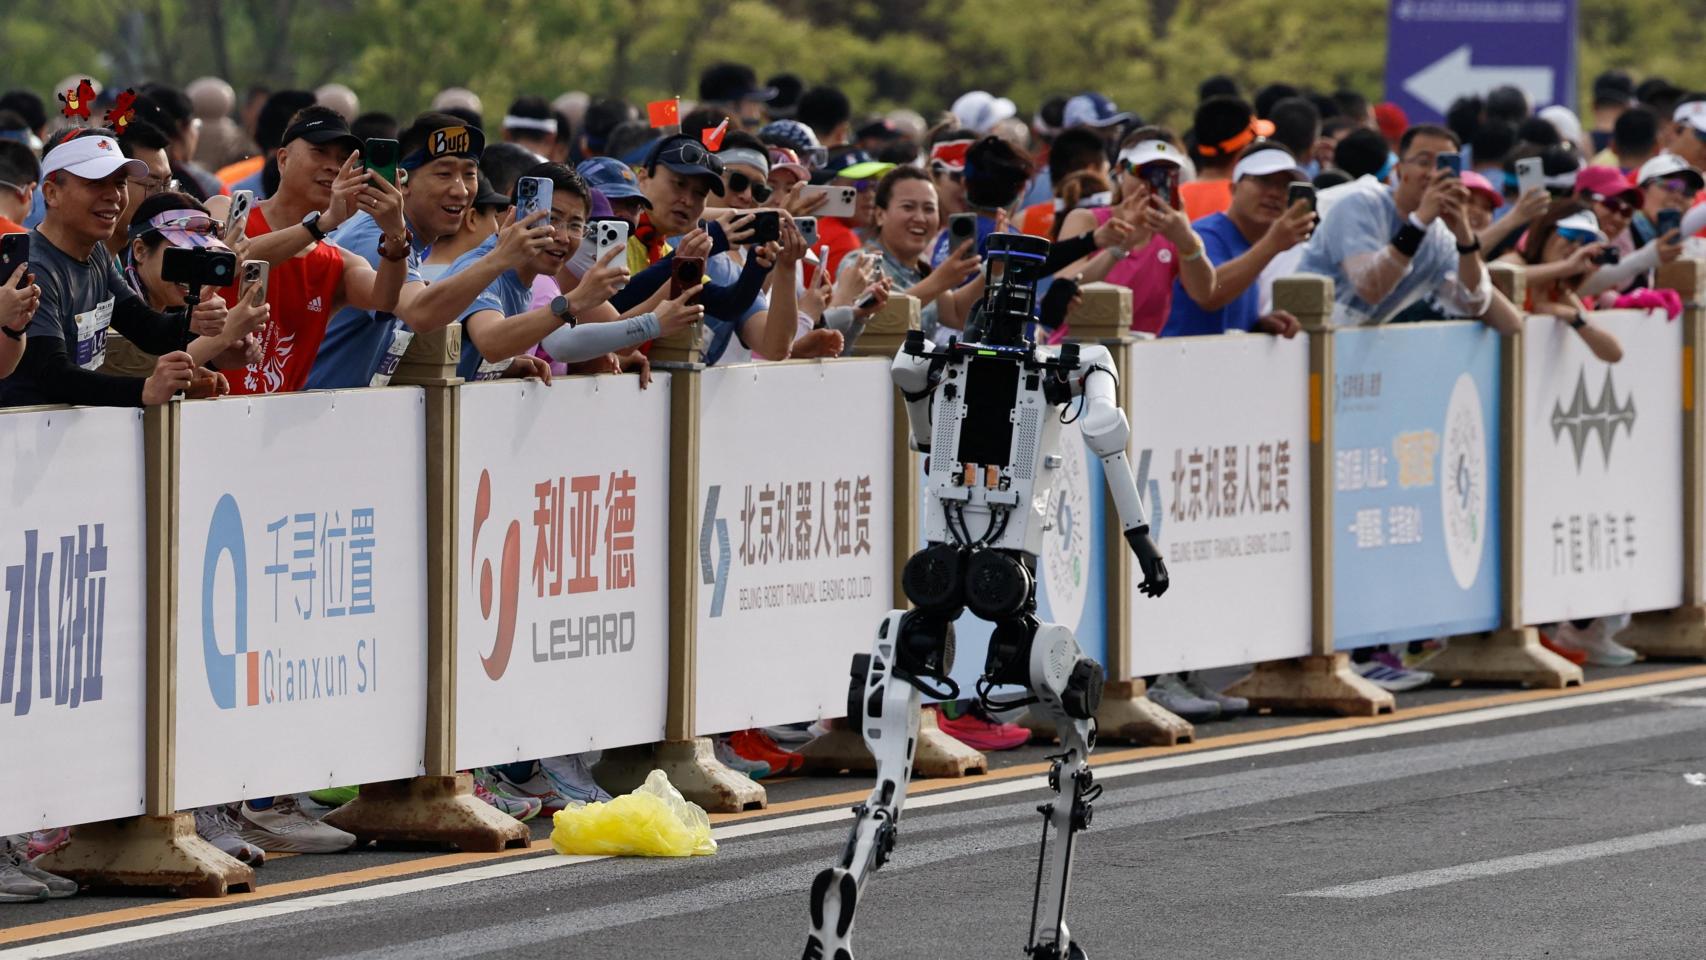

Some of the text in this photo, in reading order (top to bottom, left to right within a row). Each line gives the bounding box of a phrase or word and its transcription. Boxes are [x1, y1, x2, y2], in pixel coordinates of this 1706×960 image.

[739, 475, 872, 566] 北京机器人租赁
[1170, 440, 1290, 522] 北京机器人租赁
[264, 508, 375, 623] 千寻位置
[532, 469, 636, 598] 利亚德
[0, 523, 108, 716] 水啦
[532, 611, 635, 663] LEYARD
[740, 587, 761, 611] BEIJING
[764, 584, 784, 608] ROBOT
[786, 581, 817, 605] FINANCIAL
[819, 578, 845, 602] LEASING
[264, 638, 376, 704] Qianxun SI
